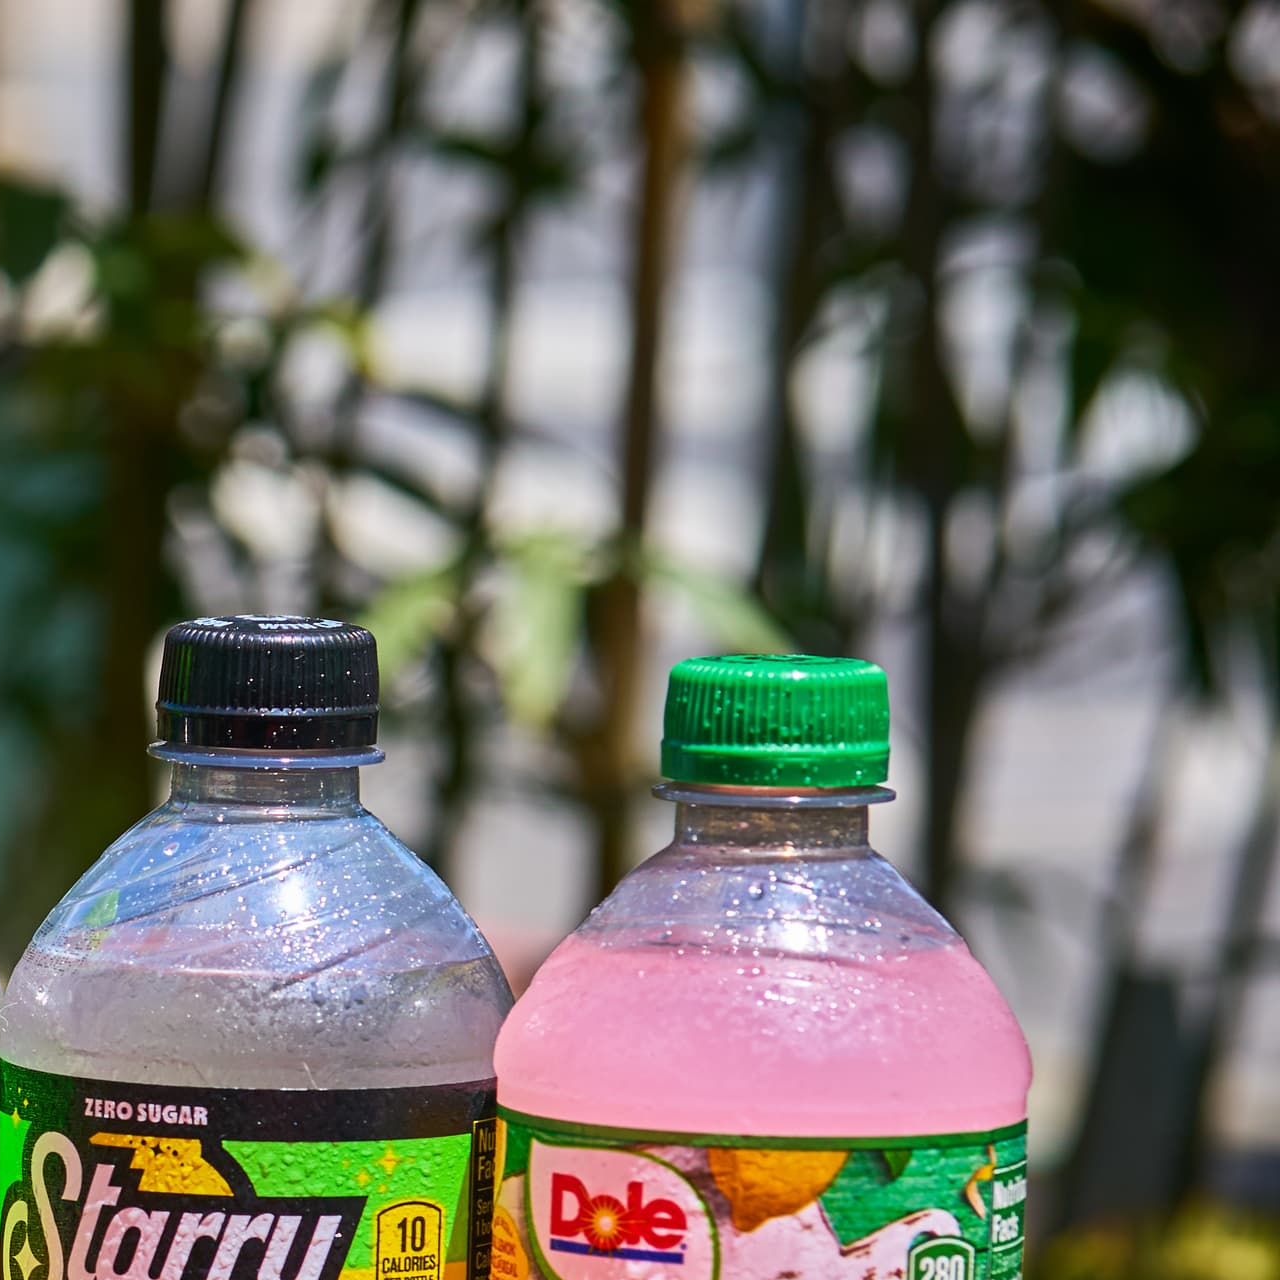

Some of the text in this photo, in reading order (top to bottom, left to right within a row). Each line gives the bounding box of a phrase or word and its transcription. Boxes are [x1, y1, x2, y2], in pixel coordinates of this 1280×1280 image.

[84, 1097, 209, 1126] ZERO SUGAR
[549, 1172, 688, 1251] Dole
[396, 1215, 426, 1253] 10
[382, 1254, 437, 1275] CALORIES
